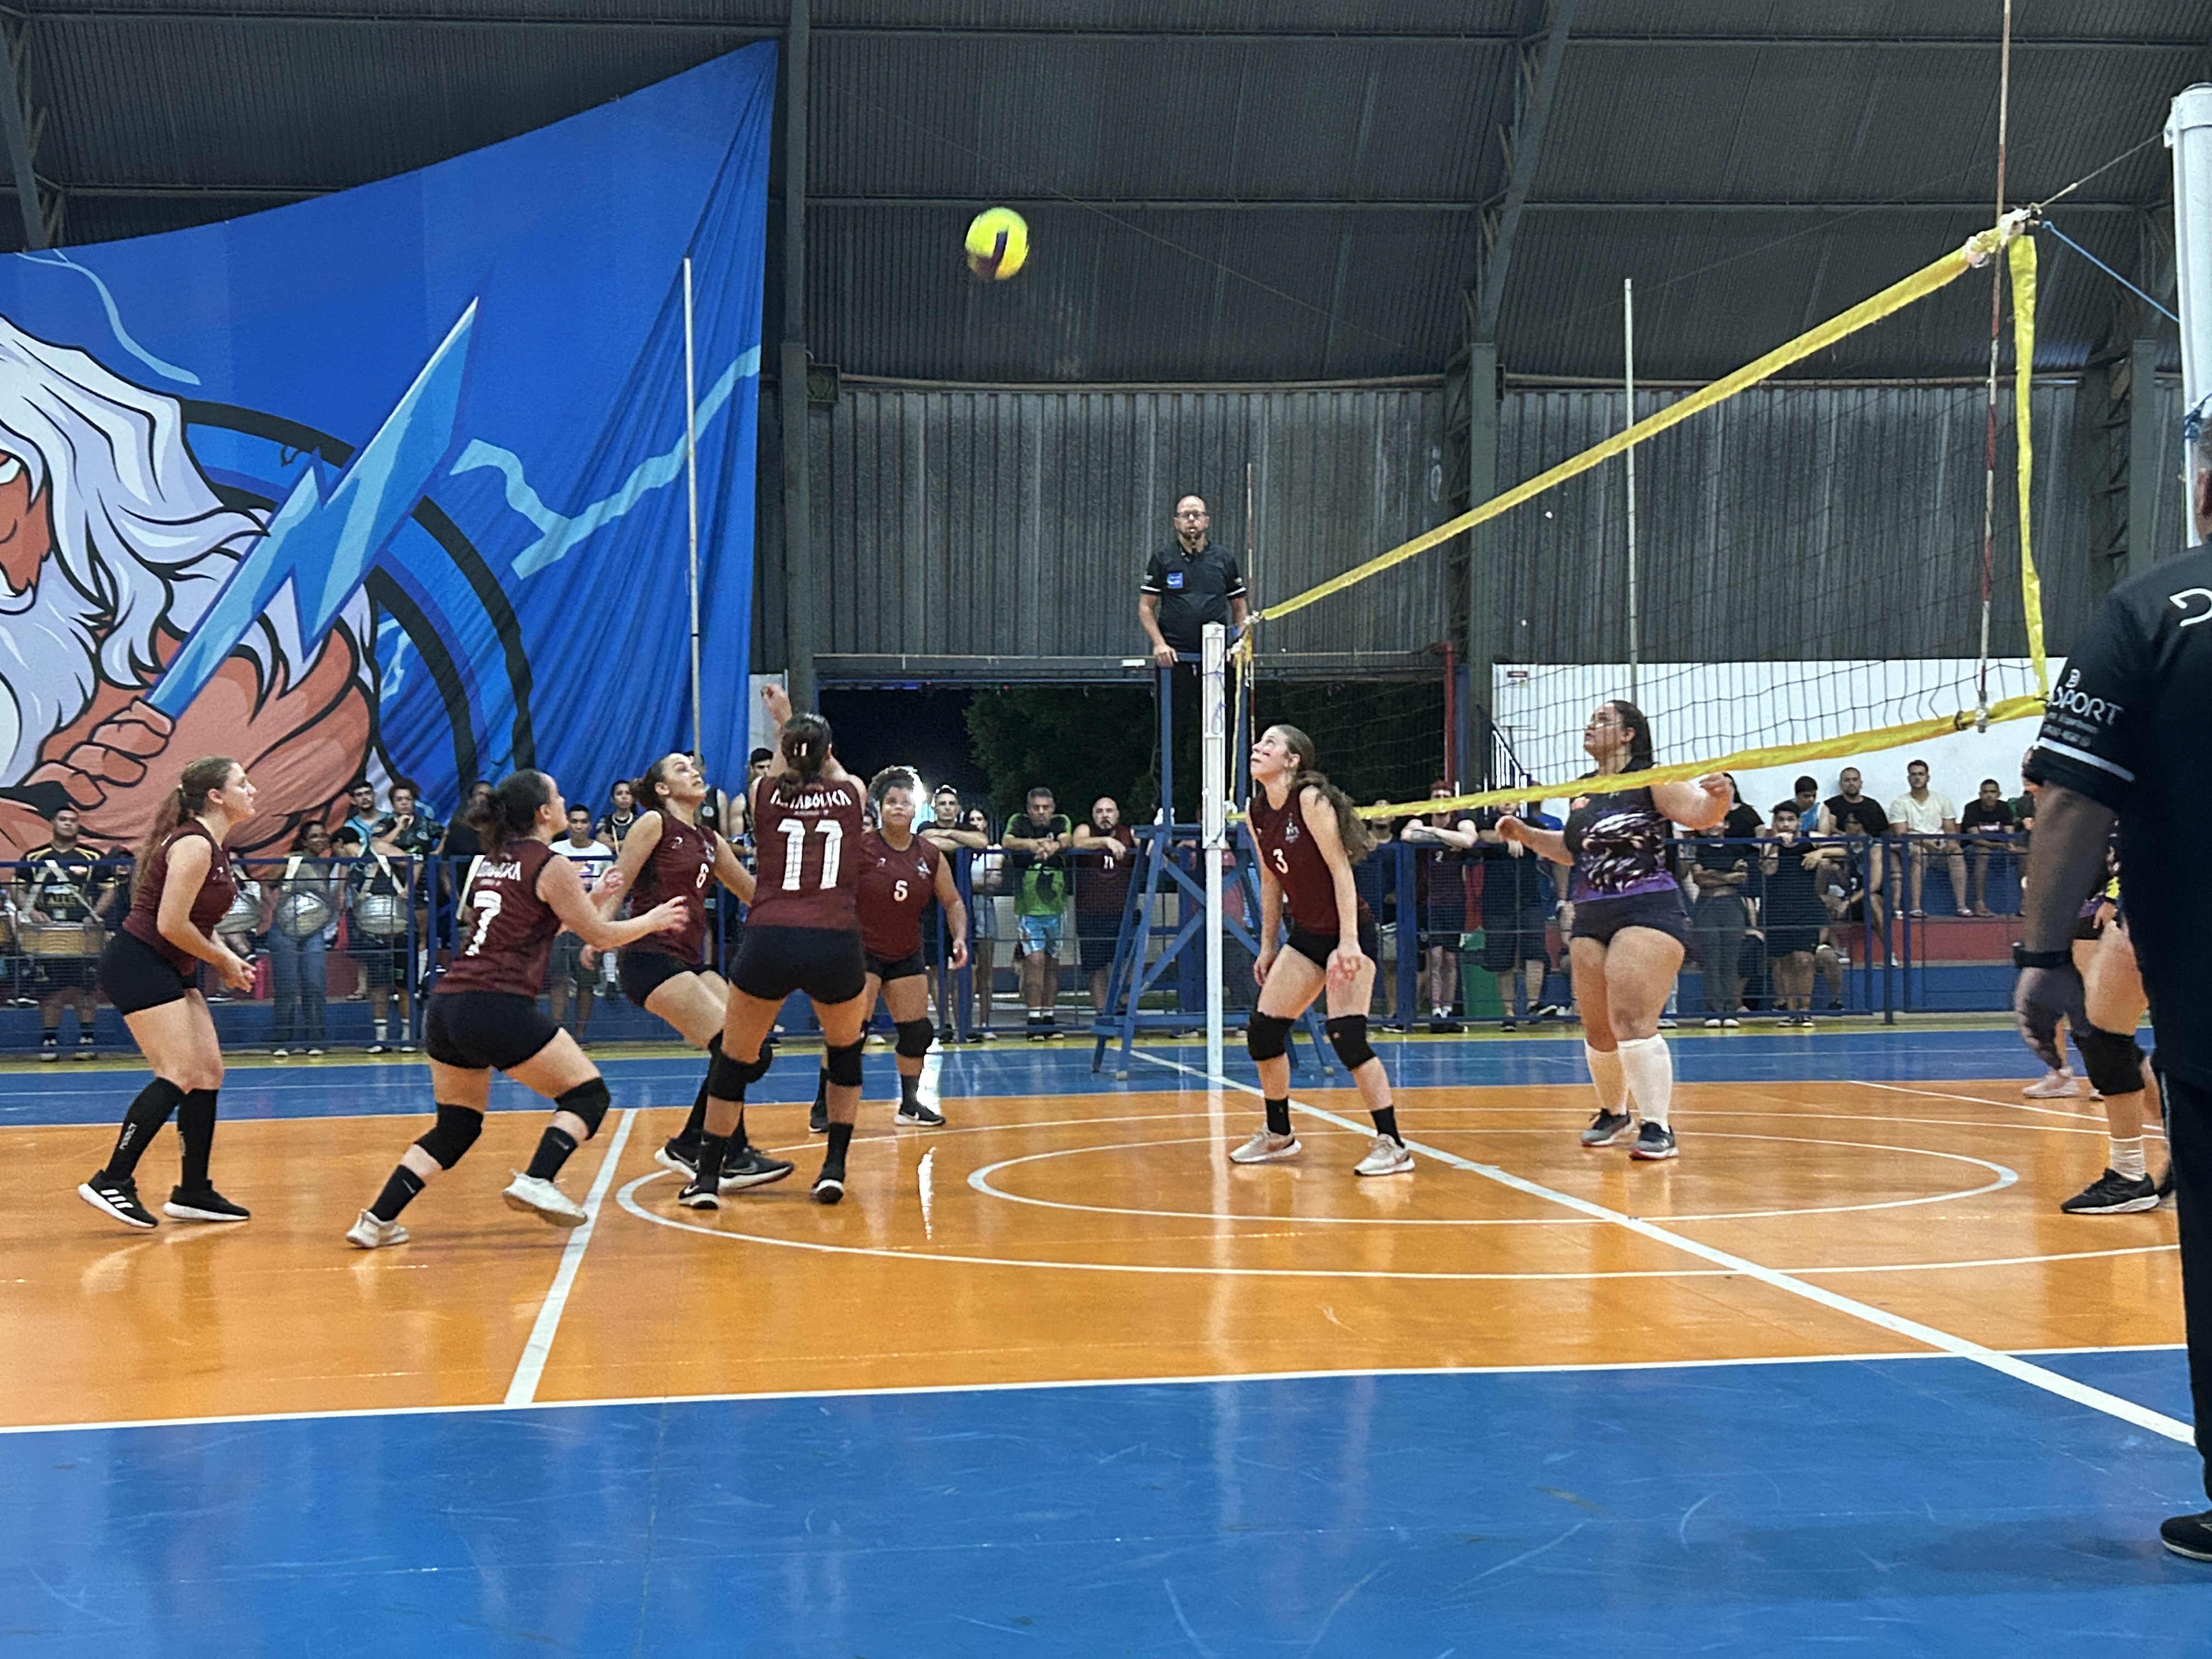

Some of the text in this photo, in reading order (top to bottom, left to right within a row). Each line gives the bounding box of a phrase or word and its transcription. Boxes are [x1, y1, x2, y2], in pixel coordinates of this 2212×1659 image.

[777, 818, 843, 891] 11
[1273, 849, 1289, 873] 3
[696, 863, 709, 888] 6
[894, 880, 908, 901] 5
[465, 890, 502, 956] 7
